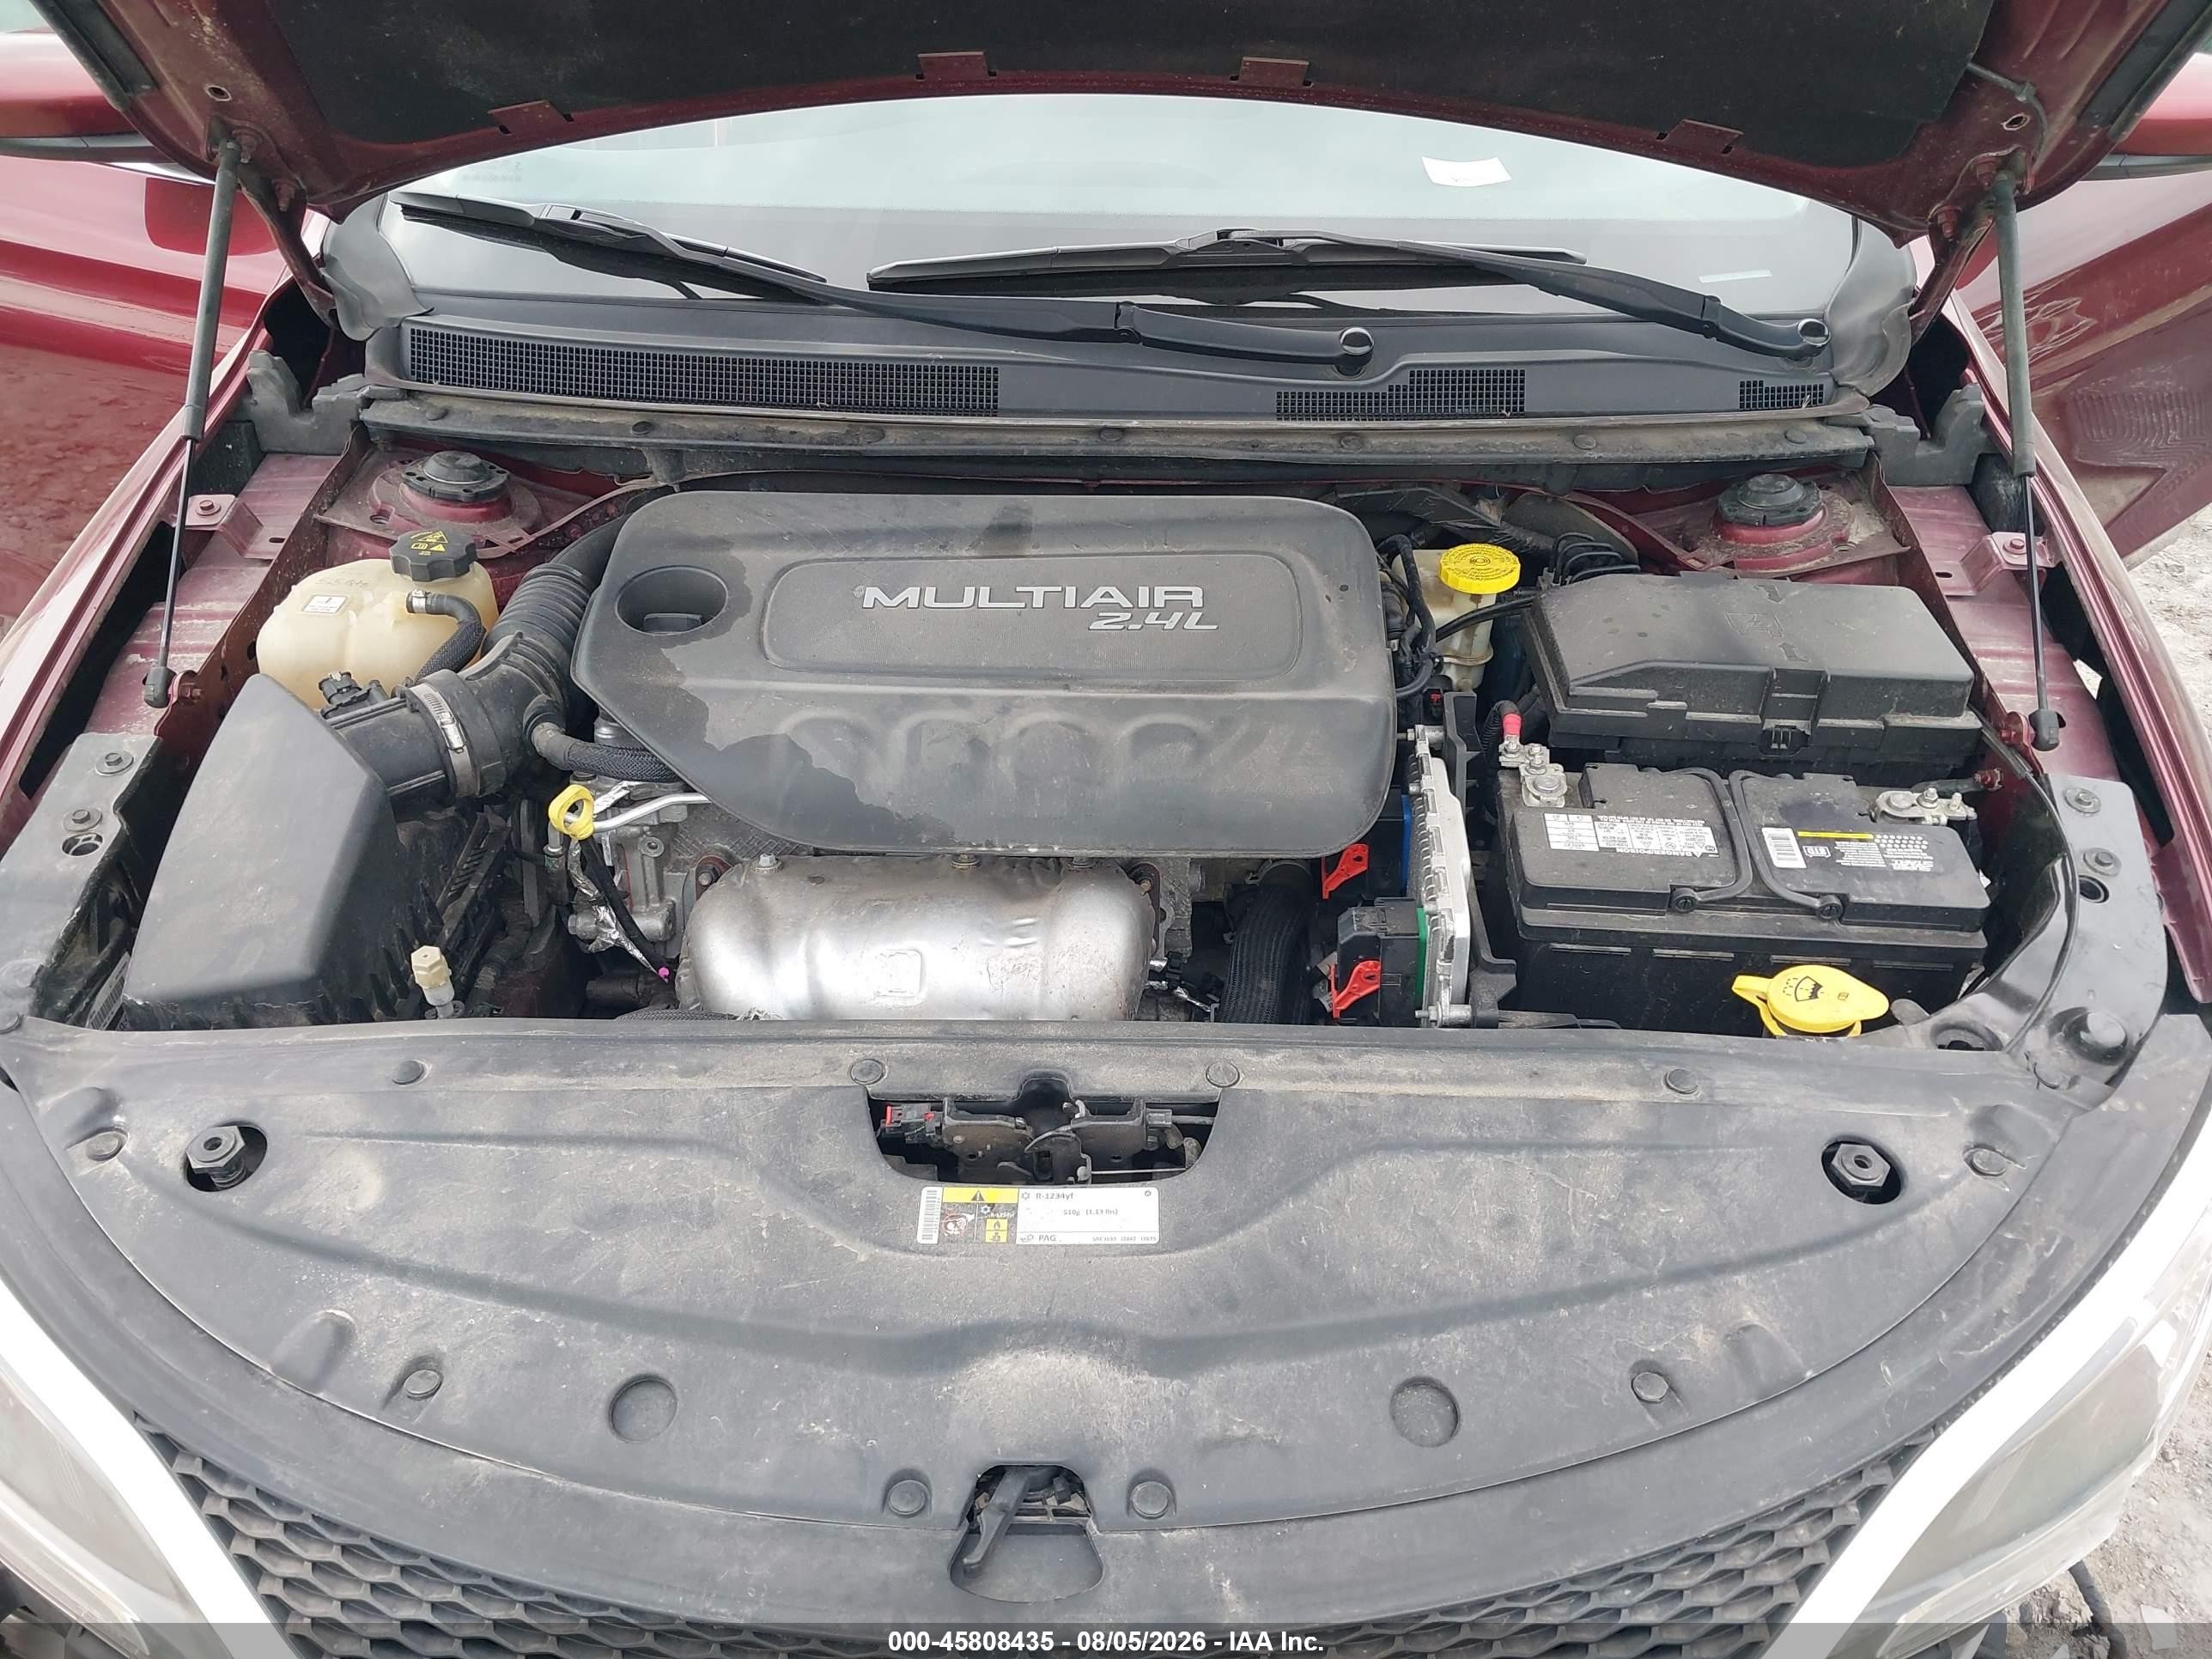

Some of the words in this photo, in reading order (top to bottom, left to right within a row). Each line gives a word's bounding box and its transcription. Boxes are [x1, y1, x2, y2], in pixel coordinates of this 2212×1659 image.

[861, 586, 1205, 610] MULTIAIR
[1088, 611, 1219, 631] 2.4L
[1035, 1192, 1074, 1201] R-1234yf
